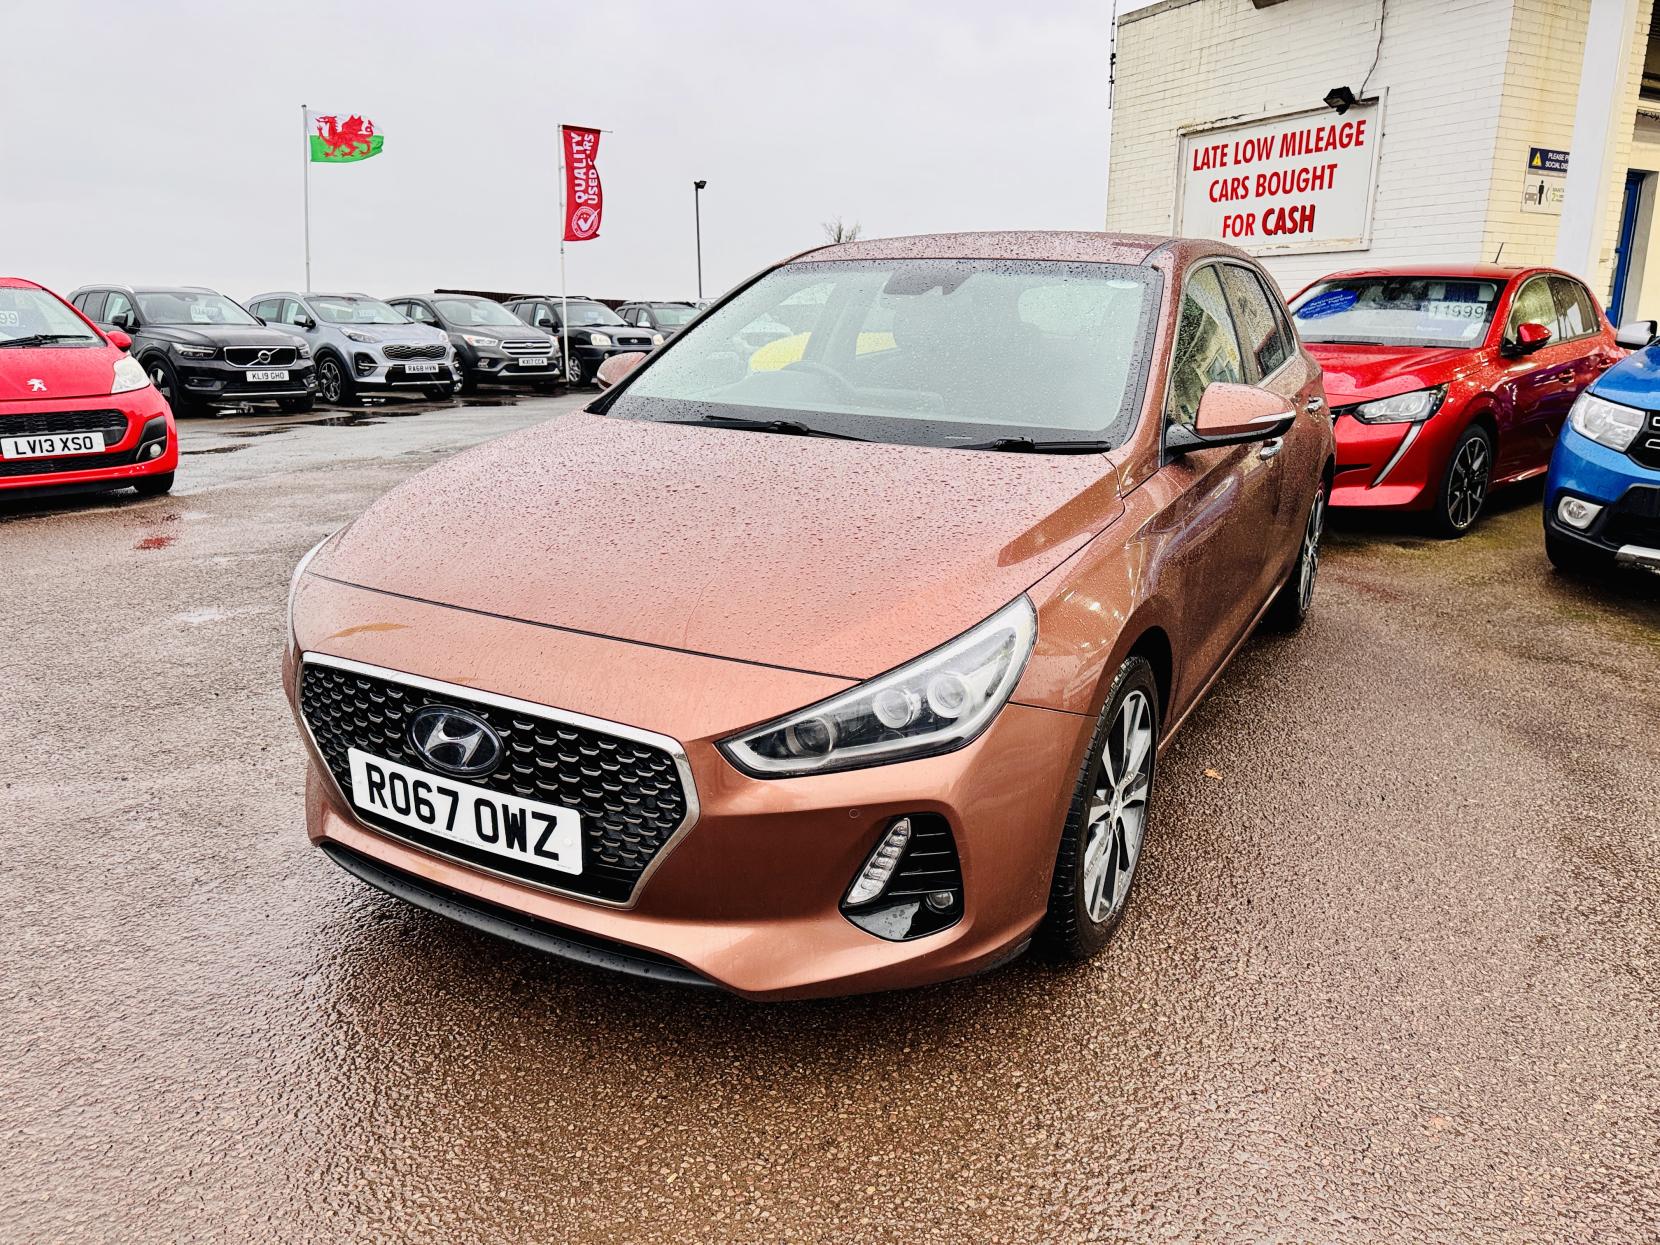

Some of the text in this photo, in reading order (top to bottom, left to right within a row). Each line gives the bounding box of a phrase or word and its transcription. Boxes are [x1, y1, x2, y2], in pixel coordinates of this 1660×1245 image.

[1193, 119, 1366, 171] LATE LOW MILEAGE
[1548, 152, 1565, 160] PLEASE
[571, 132, 588, 204] QUALITY
[1545, 160, 1560, 168] SOCIAL
[588, 169, 599, 205] USED
[1209, 163, 1337, 203] CARS BOUGHT
[1222, 203, 1316, 238] FOR CASH
[251, 372, 269, 380] KL19
[14, 435, 93, 456] LV13 XSO
[365, 762, 560, 862] RO67 OWZ
